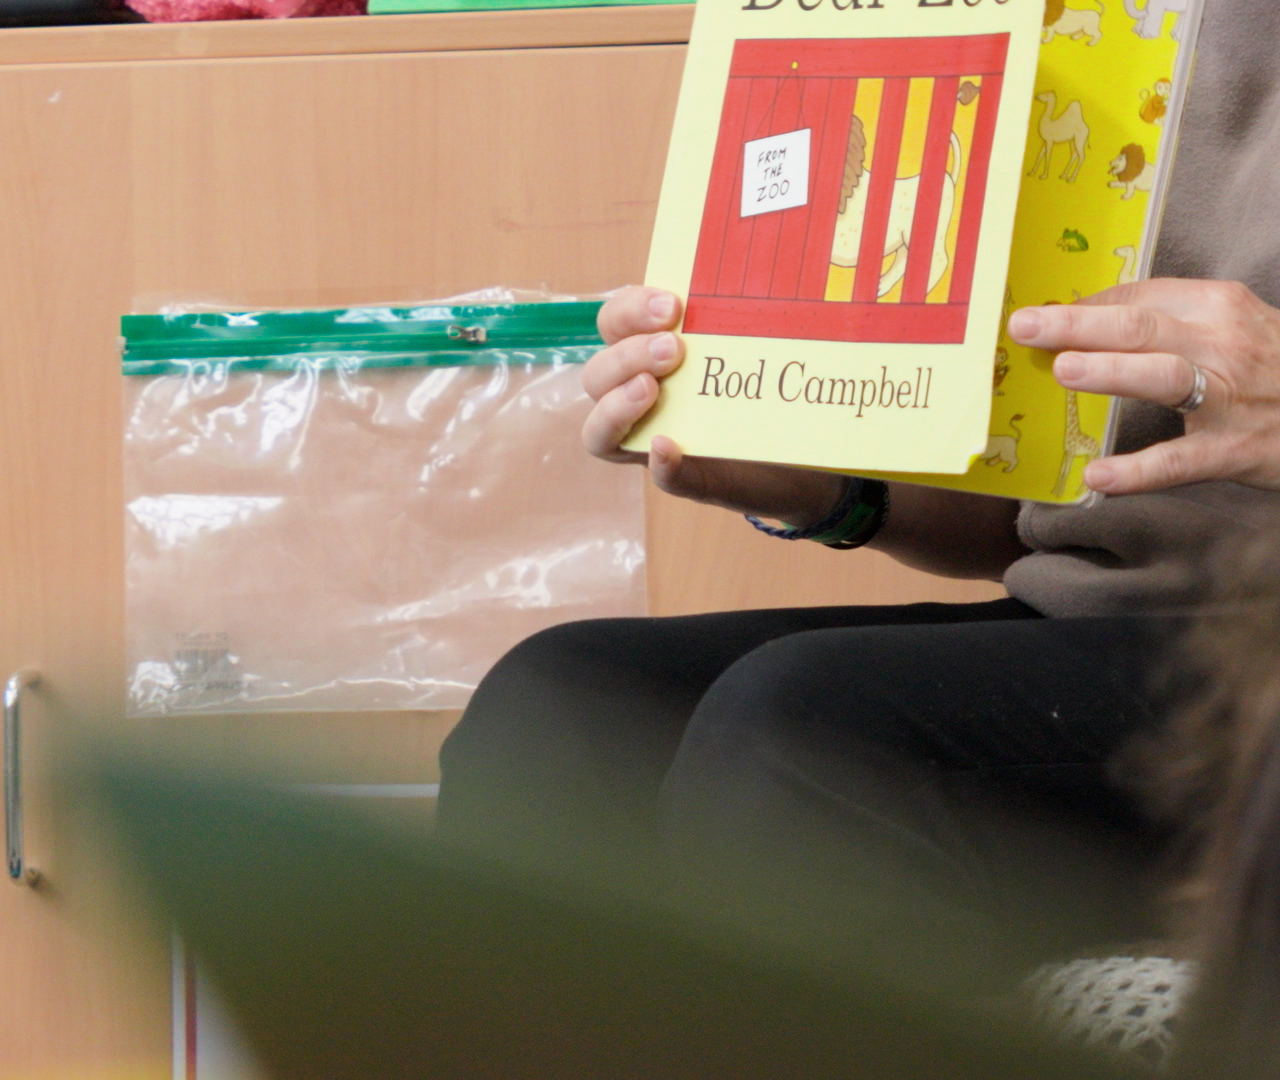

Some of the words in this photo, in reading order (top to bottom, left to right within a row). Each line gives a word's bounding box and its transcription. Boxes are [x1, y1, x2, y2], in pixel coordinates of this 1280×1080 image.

[756, 146, 788, 168] FROM
[763, 162, 784, 181] THE
[756, 178, 791, 203] ZOO
[696, 355, 767, 401] Rod
[777, 360, 934, 419] Campbell
